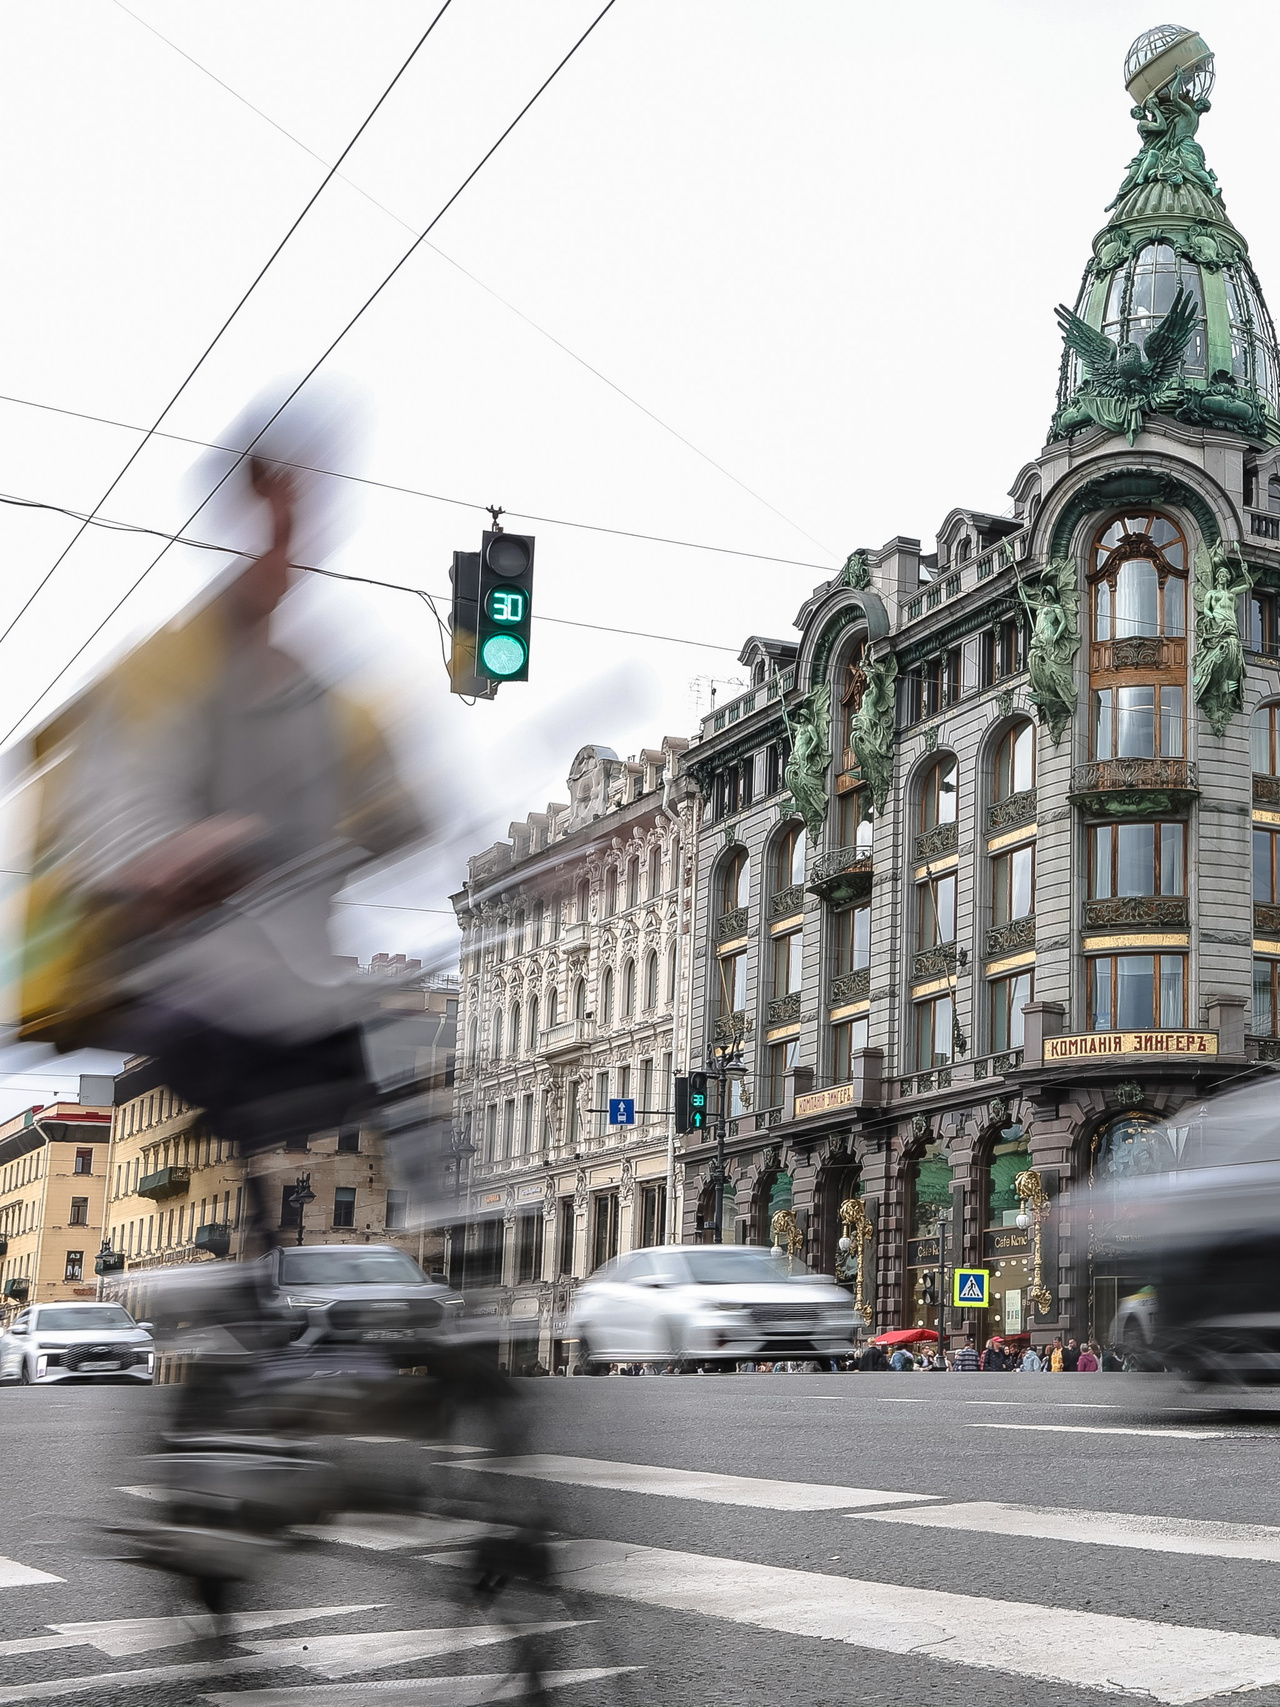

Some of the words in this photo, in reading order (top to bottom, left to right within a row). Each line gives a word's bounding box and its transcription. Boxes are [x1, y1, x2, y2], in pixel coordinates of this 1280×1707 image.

[493, 593, 522, 621] 30
[1133, 1035, 1207, 1052] ЗИНГЕРЪ
[693, 1094, 704, 1106] 38
